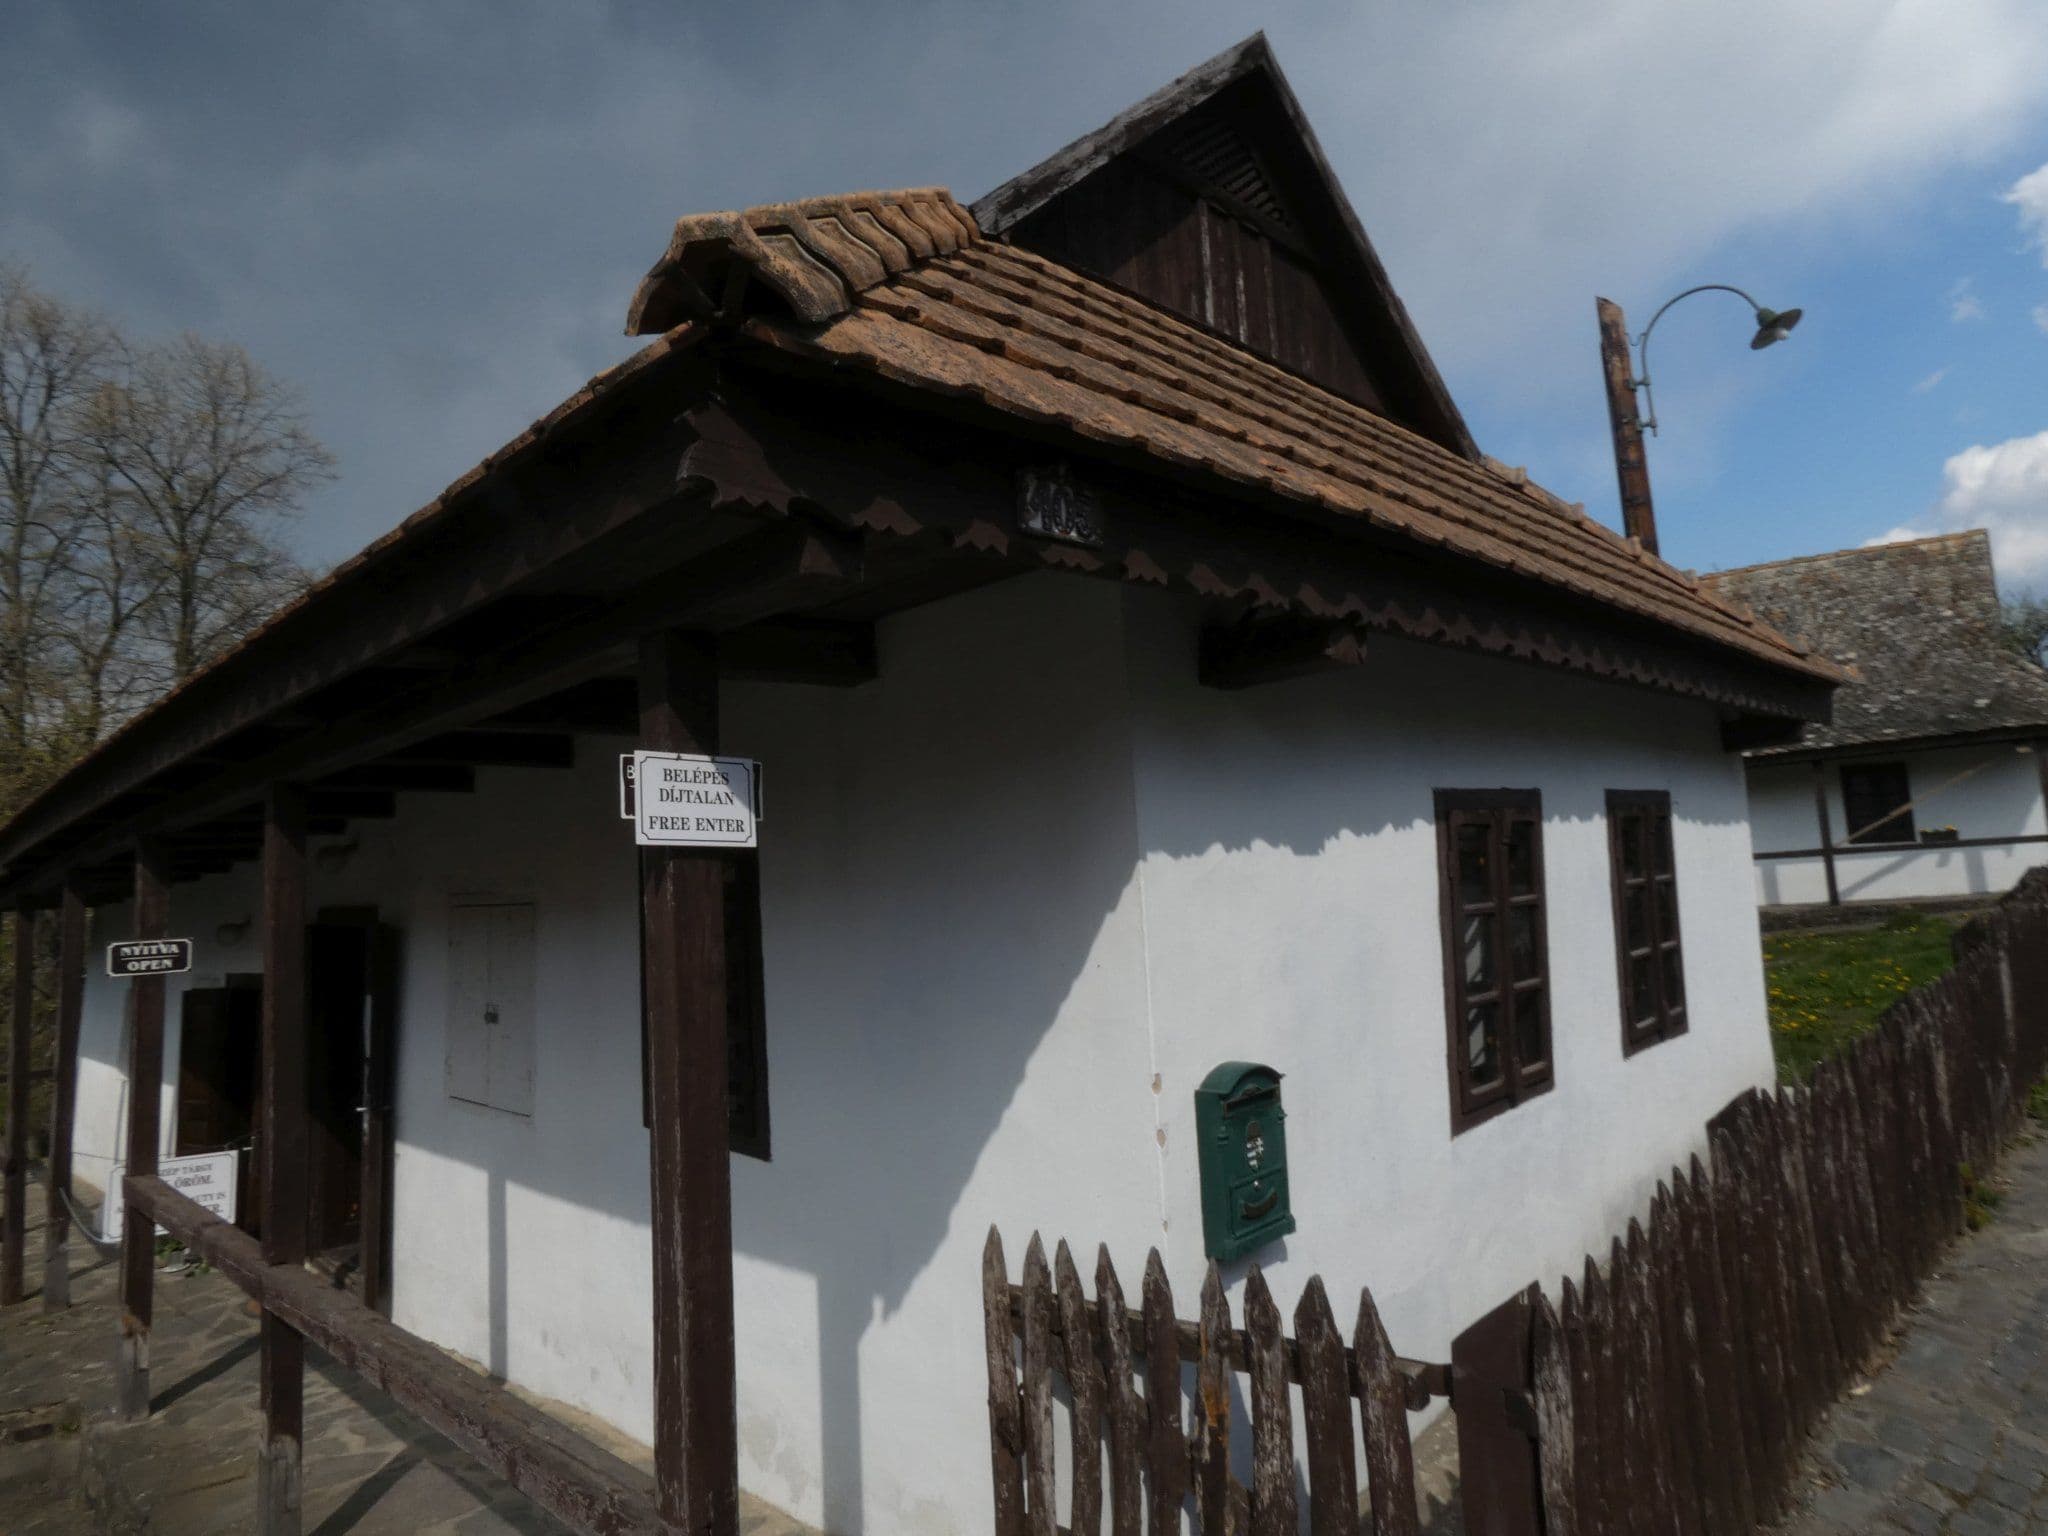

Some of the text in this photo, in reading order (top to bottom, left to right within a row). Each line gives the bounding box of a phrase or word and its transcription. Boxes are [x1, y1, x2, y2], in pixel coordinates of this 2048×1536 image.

[663, 766, 730, 786] BELÉPÉS
[659, 785, 735, 806] DÍJTALAN
[648, 815, 745, 833] FREE ENTER
[120, 943, 180, 957] NYITVA
[127, 959, 174, 972] OPEN
